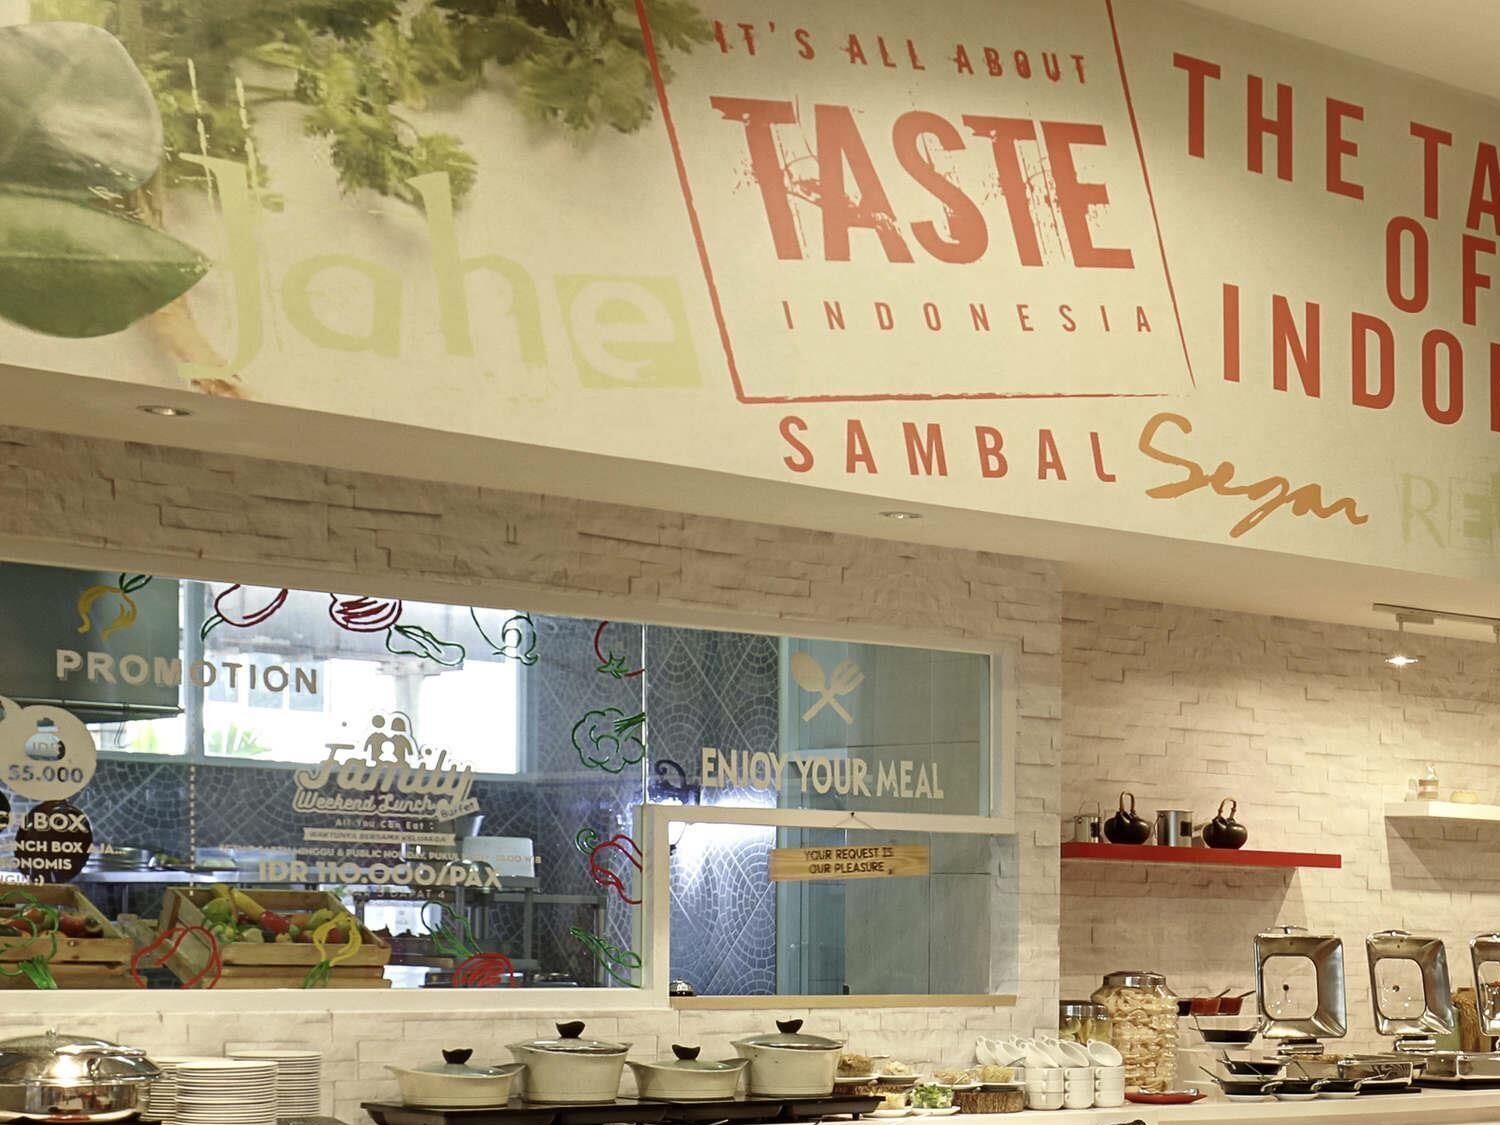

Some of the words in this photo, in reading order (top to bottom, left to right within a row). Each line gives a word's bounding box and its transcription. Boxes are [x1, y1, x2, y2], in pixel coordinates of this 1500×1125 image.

[712, 19, 816, 61] IT'S
[847, 32, 927, 71] ALL
[954, 43, 1089, 85] ABOUT
[1172, 50, 1366, 202] THE
[708, 94, 1136, 270] TASTE
[1384, 215, 1497, 327] OF
[782, 299, 1152, 335] INDONESIA
[778, 414, 1117, 484] SAMBAL
[56, 648, 319, 695] PROMOTION
[701, 747, 787, 790] ENJOY
[796, 756, 872, 798] YOUR
[876, 759, 944, 800] MEAL
[299, 790, 376, 812] Weekend
[33, 812, 88, 833] BOX
[51, 841, 83, 854] BOX
[804, 850, 832, 861] YOUR
[835, 848, 879, 860] REQUEST
[808, 863, 832, 874] OUR
[834, 862, 884, 874] PLEASURE
[259, 861, 308, 883] IDR
